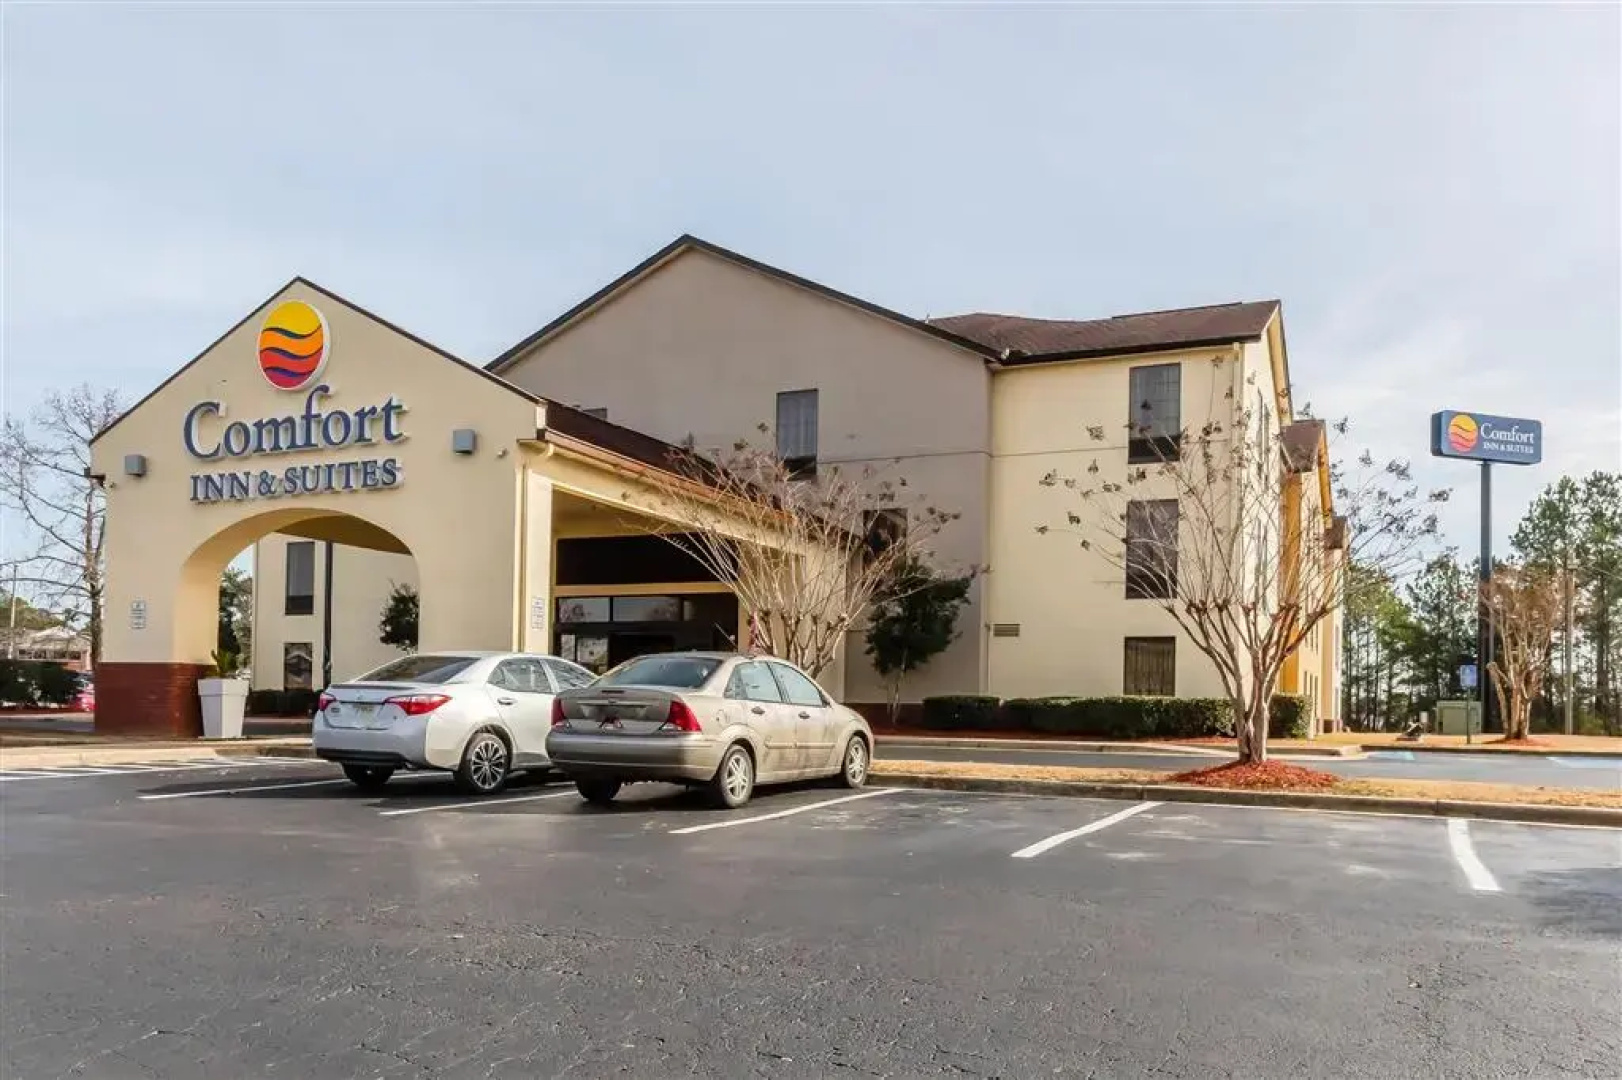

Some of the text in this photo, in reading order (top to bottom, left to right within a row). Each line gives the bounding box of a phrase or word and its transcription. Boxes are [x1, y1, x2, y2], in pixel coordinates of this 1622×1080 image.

[184, 384, 407, 459] Comfort
[1481, 423, 1533, 443] Comfort
[1483, 442, 1499, 450] INN
[1506, 444, 1534, 453] SUITES
[190, 458, 400, 501] INN & SUITES
